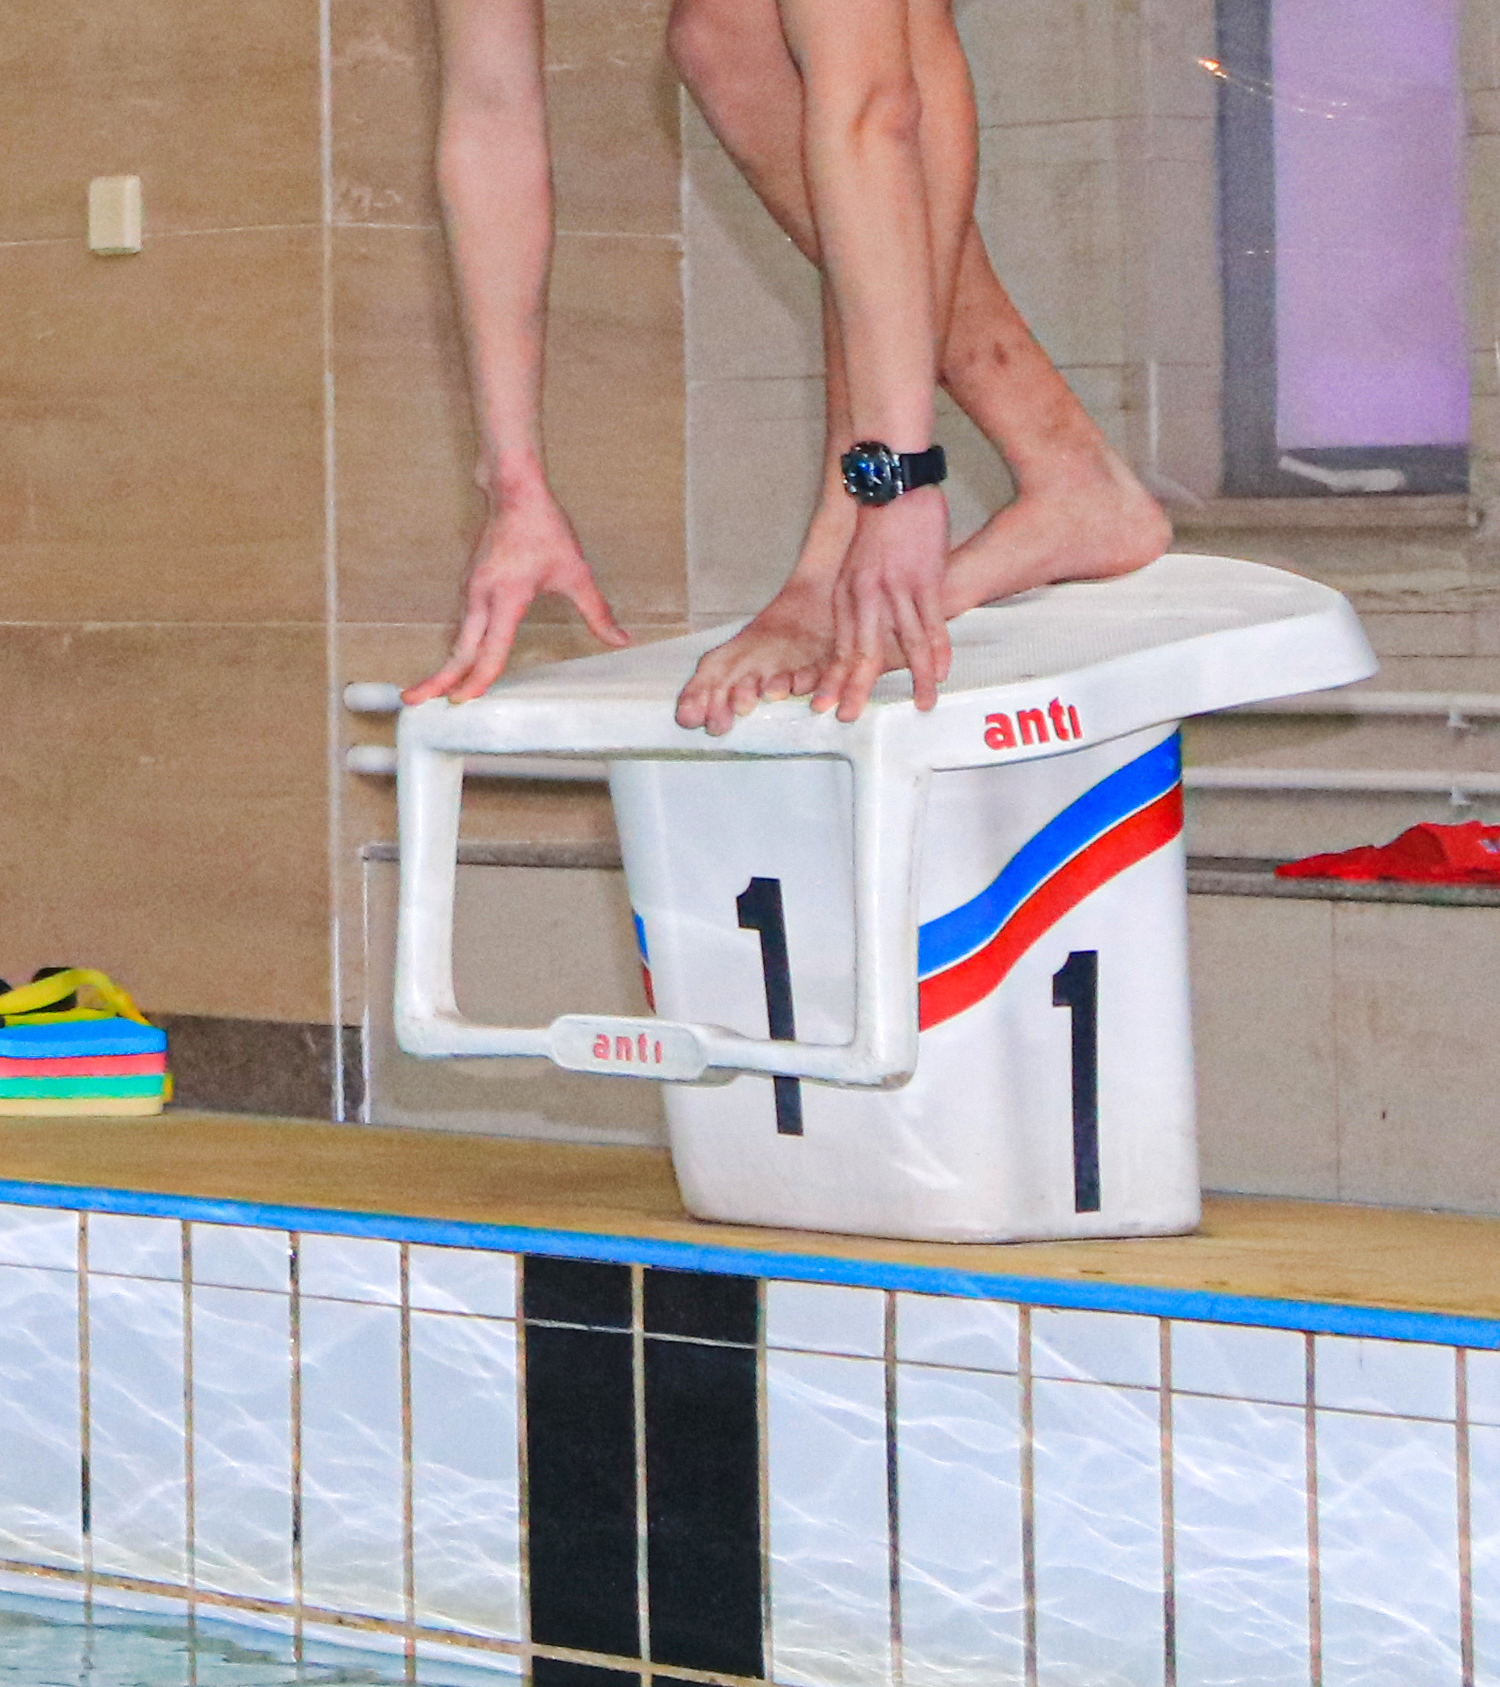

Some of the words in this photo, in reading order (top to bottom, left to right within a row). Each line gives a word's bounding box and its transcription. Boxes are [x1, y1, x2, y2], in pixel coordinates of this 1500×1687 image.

[983, 697, 1084, 751] anti
[591, 1029, 663, 1066] anti
[736, 876, 804, 1137] 1
[1051, 949, 1101, 1214] 1
